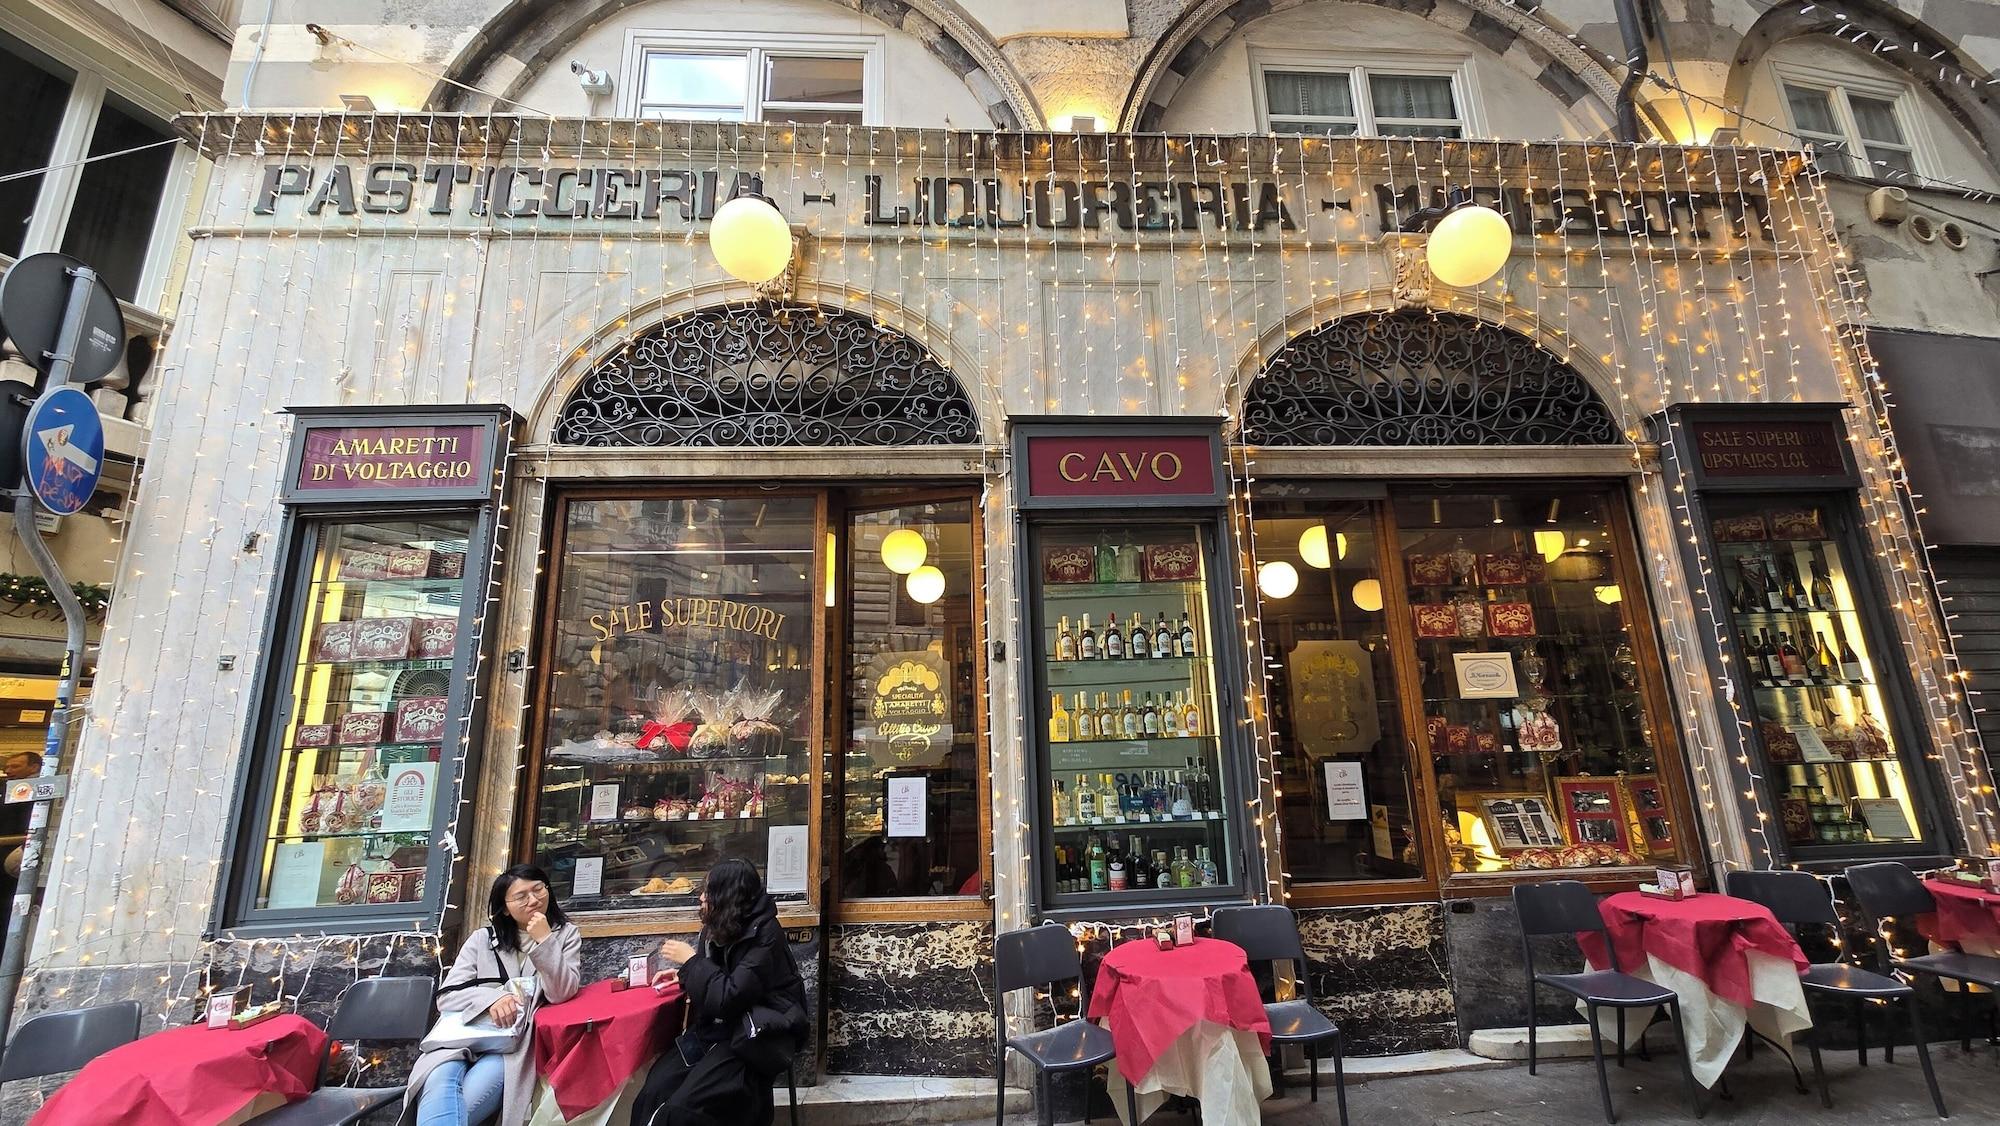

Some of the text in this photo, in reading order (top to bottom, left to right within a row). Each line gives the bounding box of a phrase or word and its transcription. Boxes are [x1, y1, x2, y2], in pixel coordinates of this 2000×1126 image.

[863, 175, 1296, 231] LIQUORERIA
[330, 436, 459, 457] AMARETTI
[1702, 431, 1743, 447] SALE
[311, 460, 472, 481] DI VOLTAGGIO
[1058, 451, 1183, 482] CAVO
[1702, 452, 1778, 469] UPSTAIRS
[589, 598, 787, 642] SALE SUPERIORI
